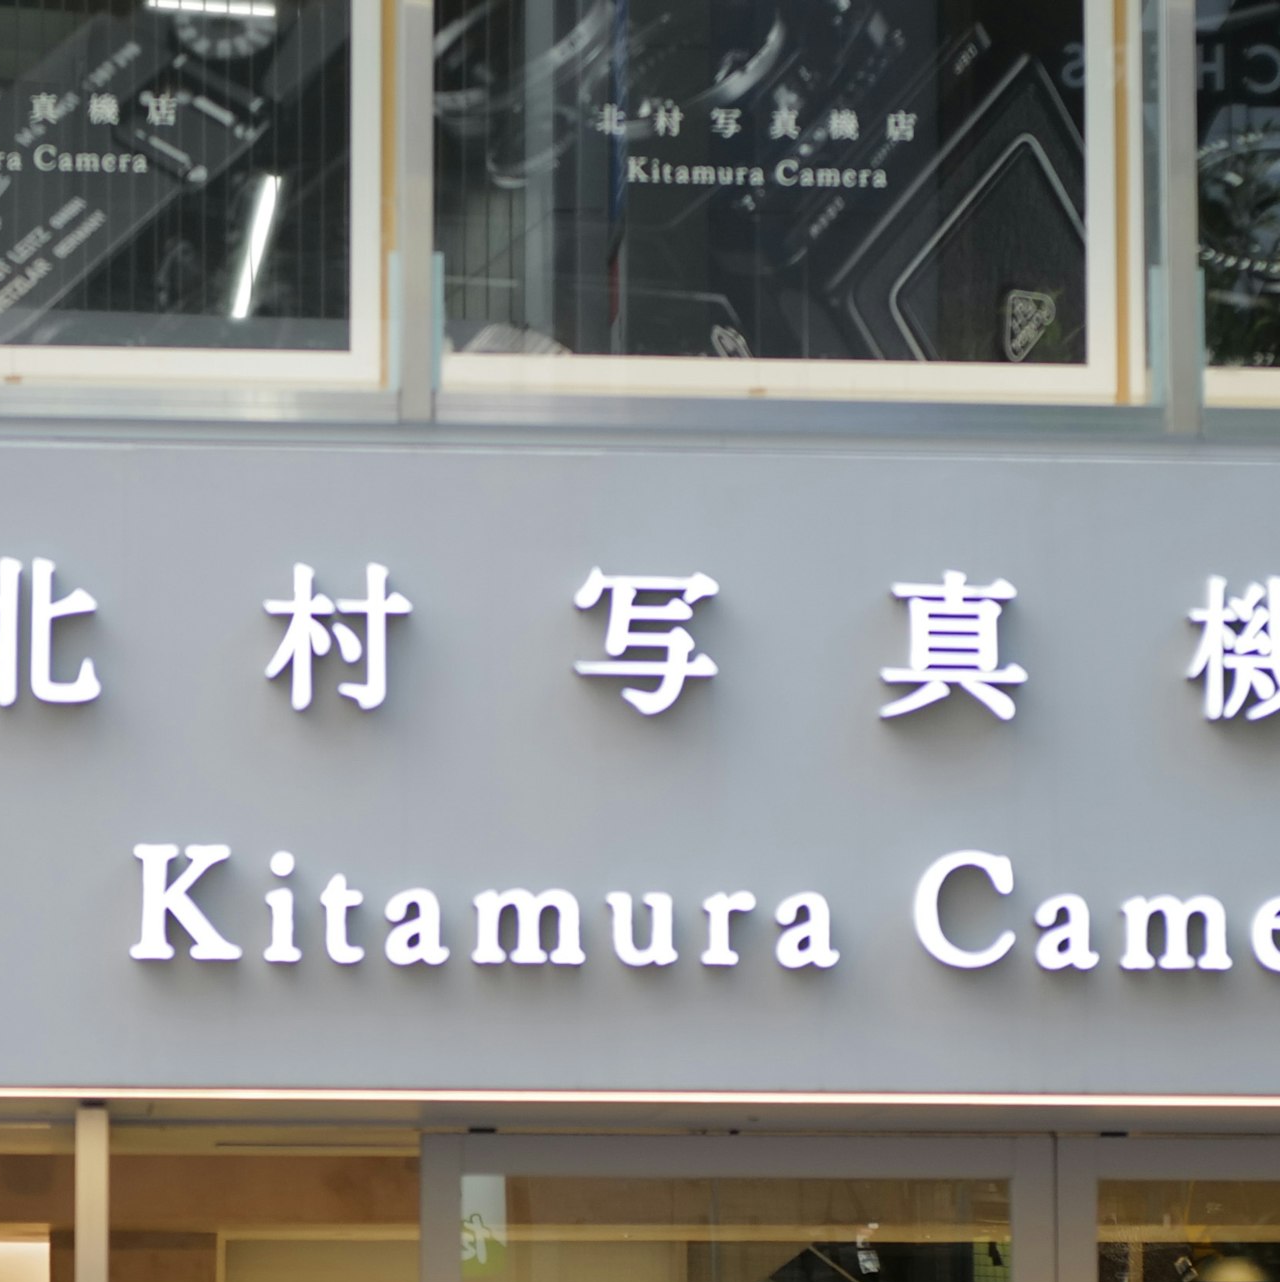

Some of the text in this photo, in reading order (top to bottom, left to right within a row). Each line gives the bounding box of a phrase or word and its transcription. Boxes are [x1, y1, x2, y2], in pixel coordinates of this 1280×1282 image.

[596, 103, 918, 141] 北村写真機店
[33, 143, 148, 174] Camera
[627, 156, 888, 188] Kitamura Camera
[129, 843, 840, 968] Kitamura
